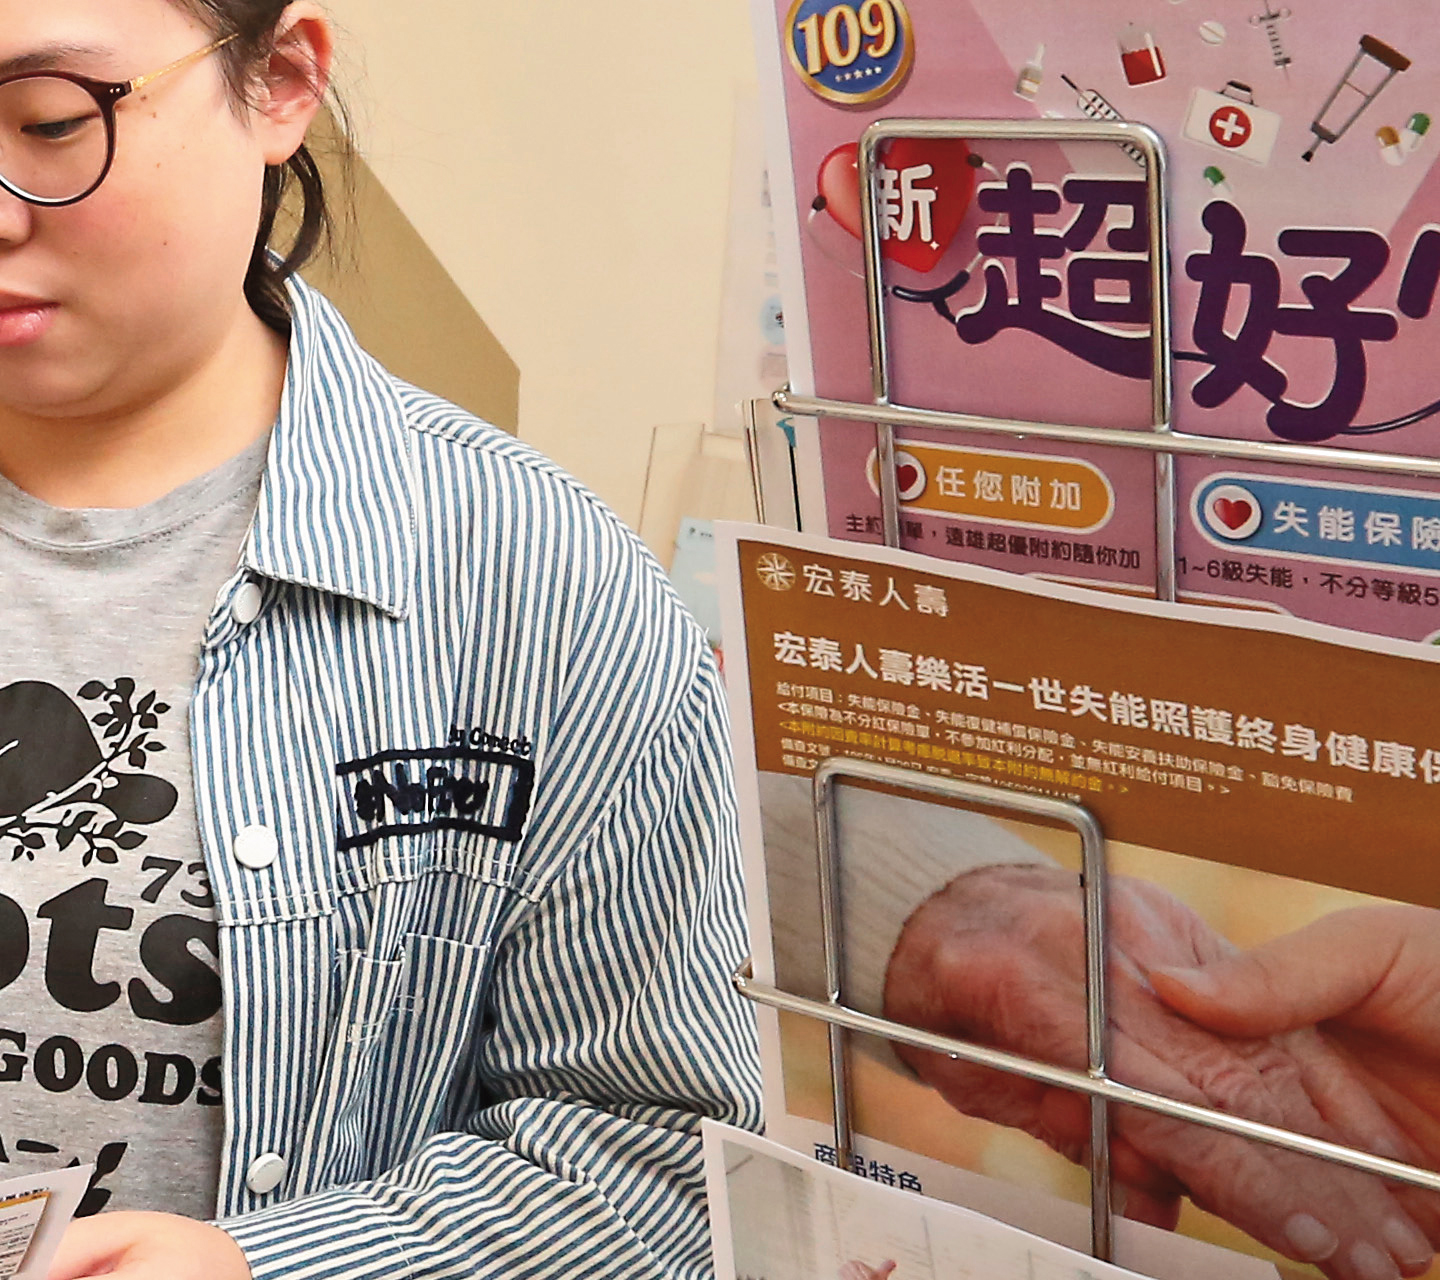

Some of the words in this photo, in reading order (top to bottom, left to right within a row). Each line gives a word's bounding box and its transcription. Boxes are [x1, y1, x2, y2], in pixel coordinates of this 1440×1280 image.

[876, 162, 938, 245] 新
[935, 465, 1083, 514] 任您附加
[846, 514, 1140, 570] 主約單，遠雄超優附約隨你加
[803, 564, 949, 618] 宏泰人壽
